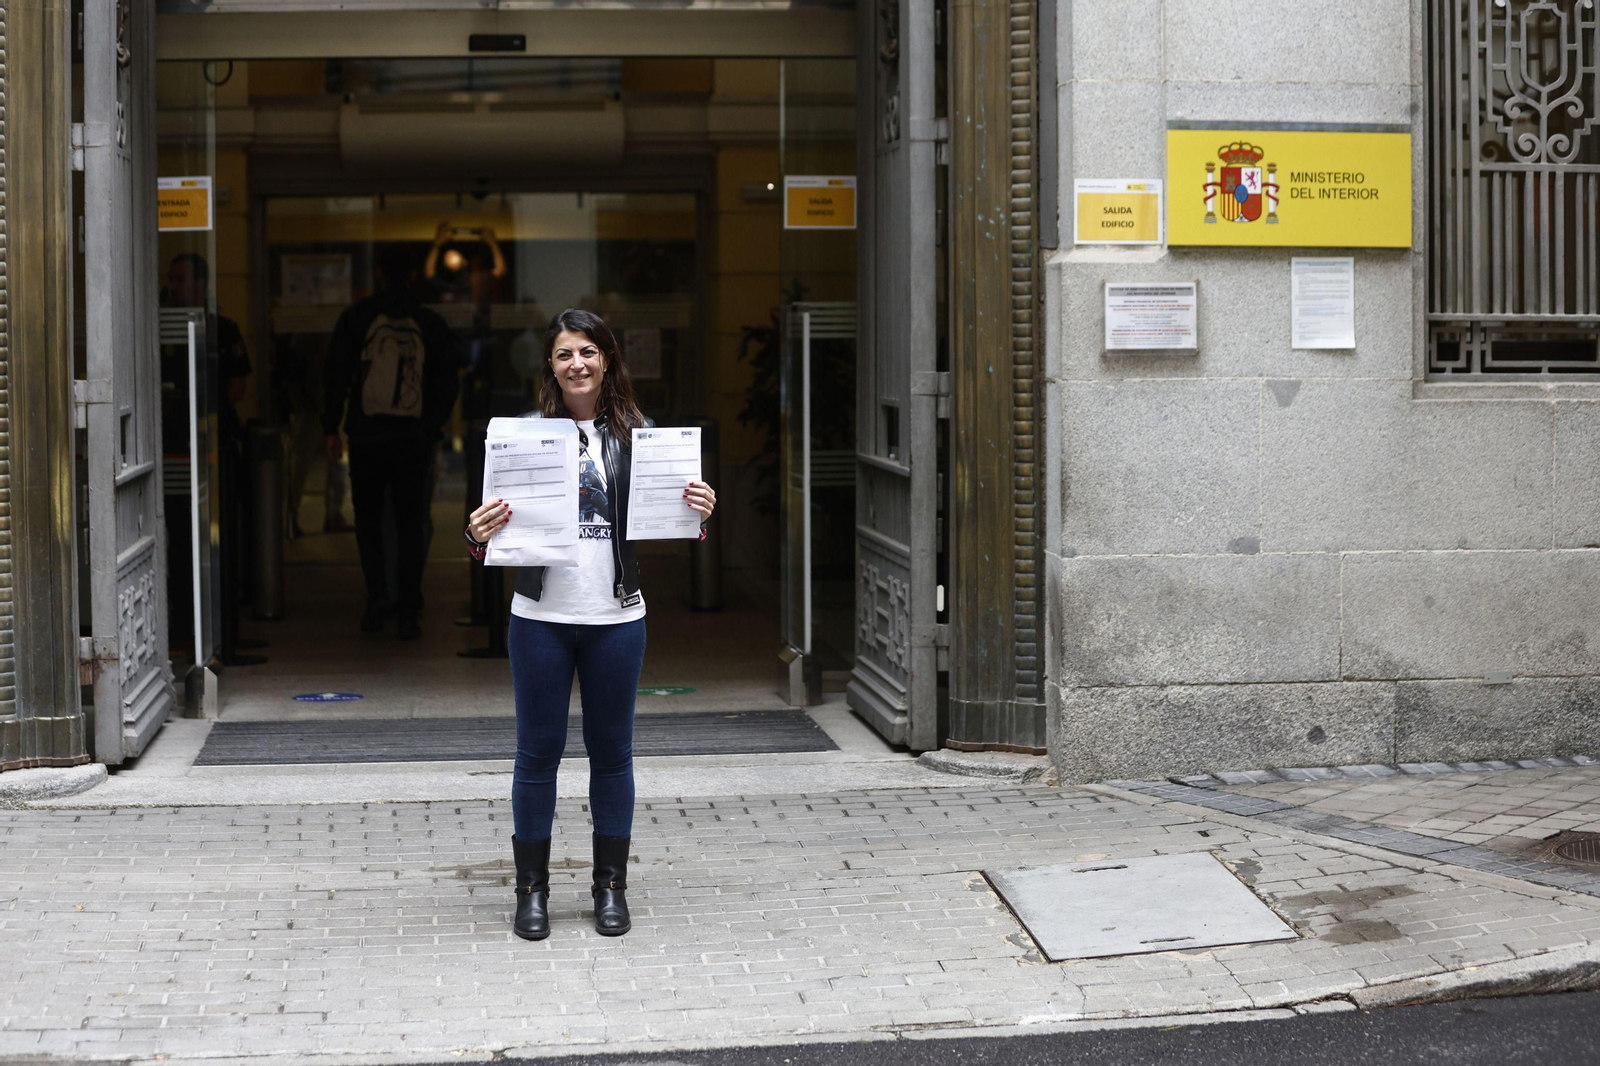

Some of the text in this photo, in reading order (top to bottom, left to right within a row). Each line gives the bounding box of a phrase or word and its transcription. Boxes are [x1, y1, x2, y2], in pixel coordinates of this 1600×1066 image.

[1290, 172, 1365, 184] MINISTERIO
[1290, 187, 1379, 200] DEL INTERIOR
[580, 528, 612, 538] ANGRY
